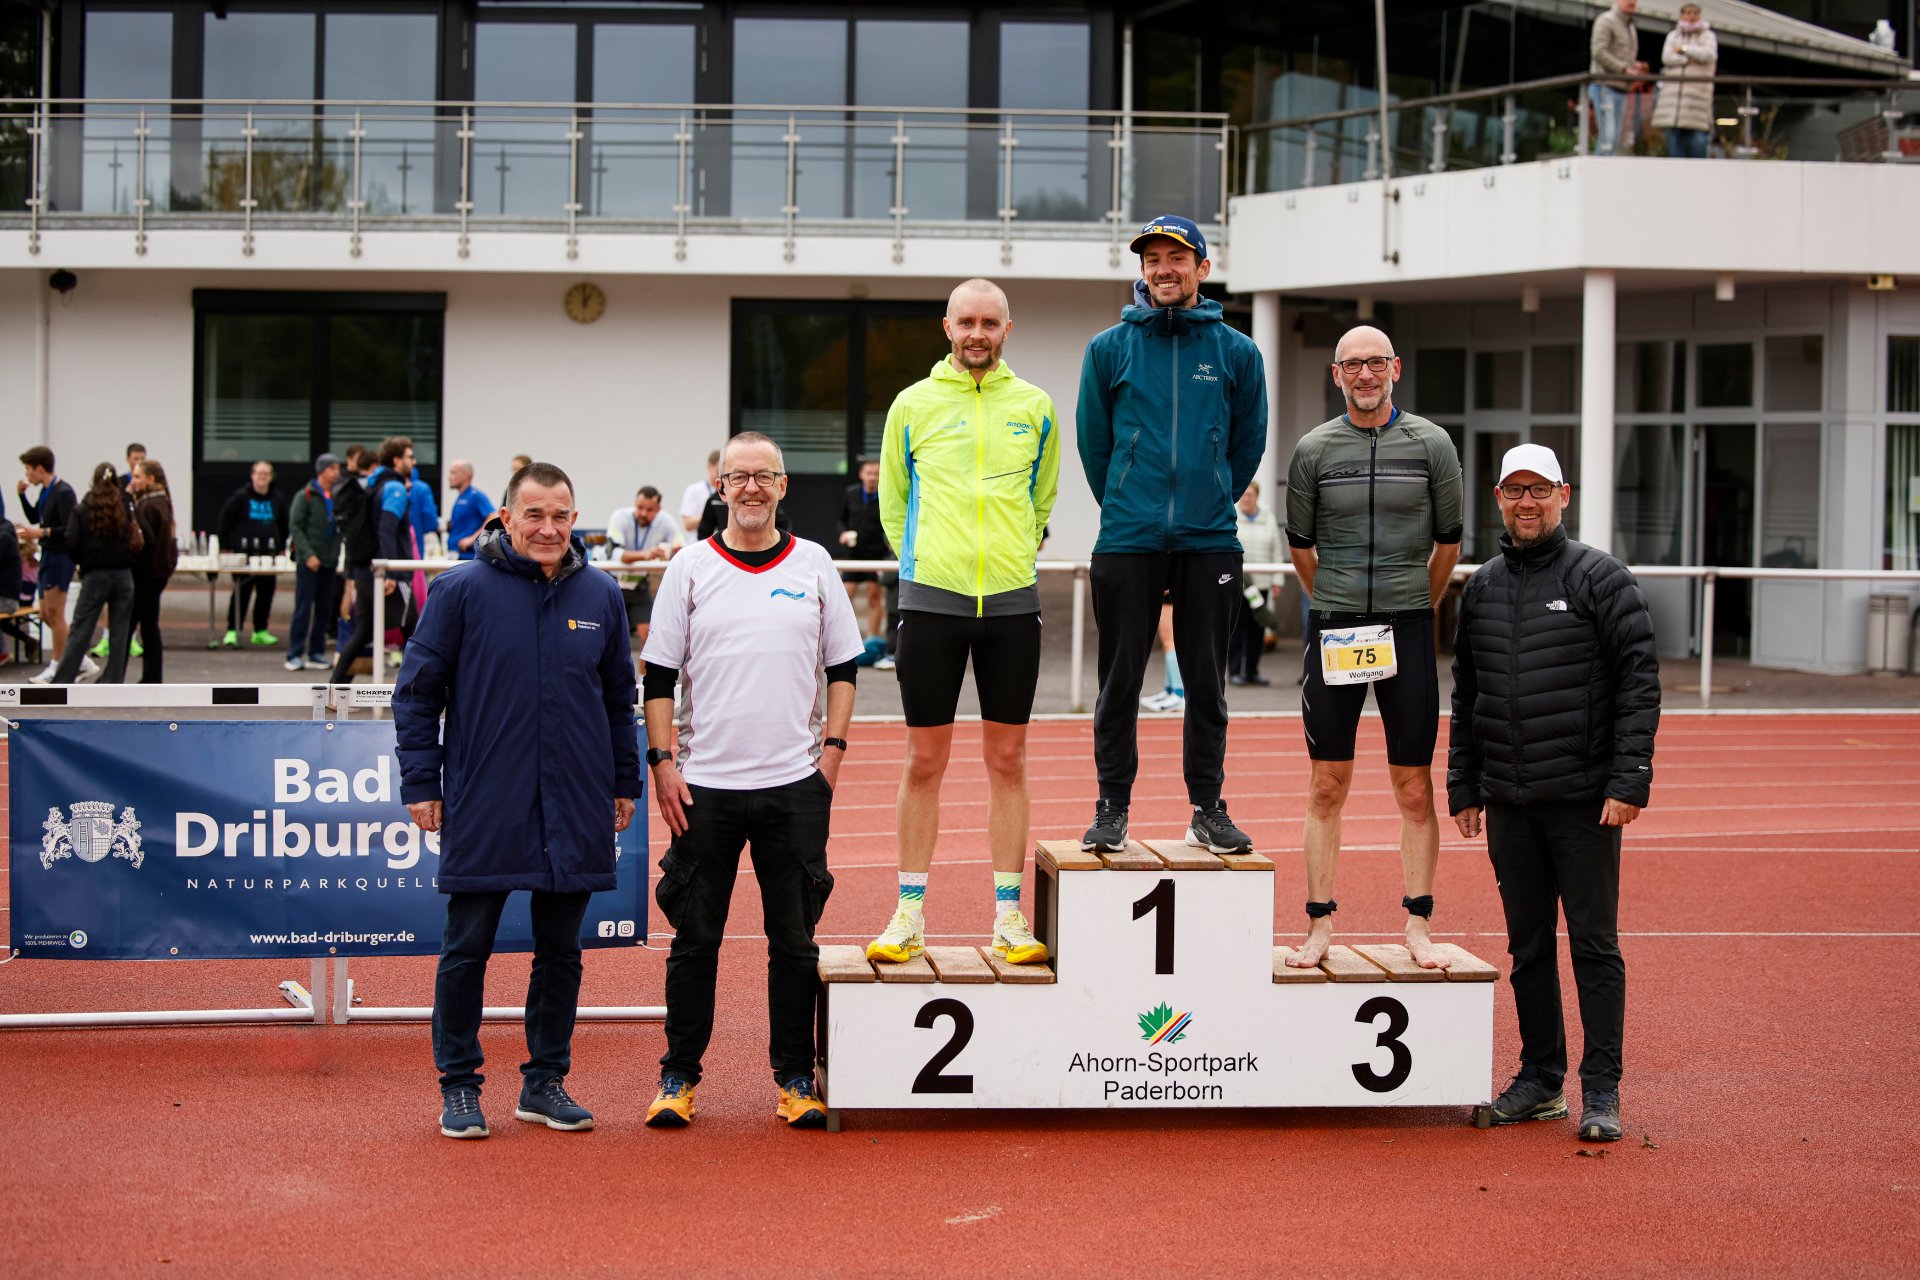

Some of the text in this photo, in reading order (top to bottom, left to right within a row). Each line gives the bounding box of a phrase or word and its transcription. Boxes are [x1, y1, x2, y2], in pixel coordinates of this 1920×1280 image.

[1353, 647, 1377, 666] 75
[1349, 670, 1384, 679] Wolfgang
[274, 755, 391, 803] Bad
[250, 930, 415, 946] www.bad-driburger.de
[1133, 879, 1176, 975] 1
[912, 998, 974, 1093] 2
[1352, 997, 1412, 1092] 3
[1069, 1052, 1259, 1077] Ahorn-Sportpark
[1105, 1080, 1223, 1100] Paderborn
